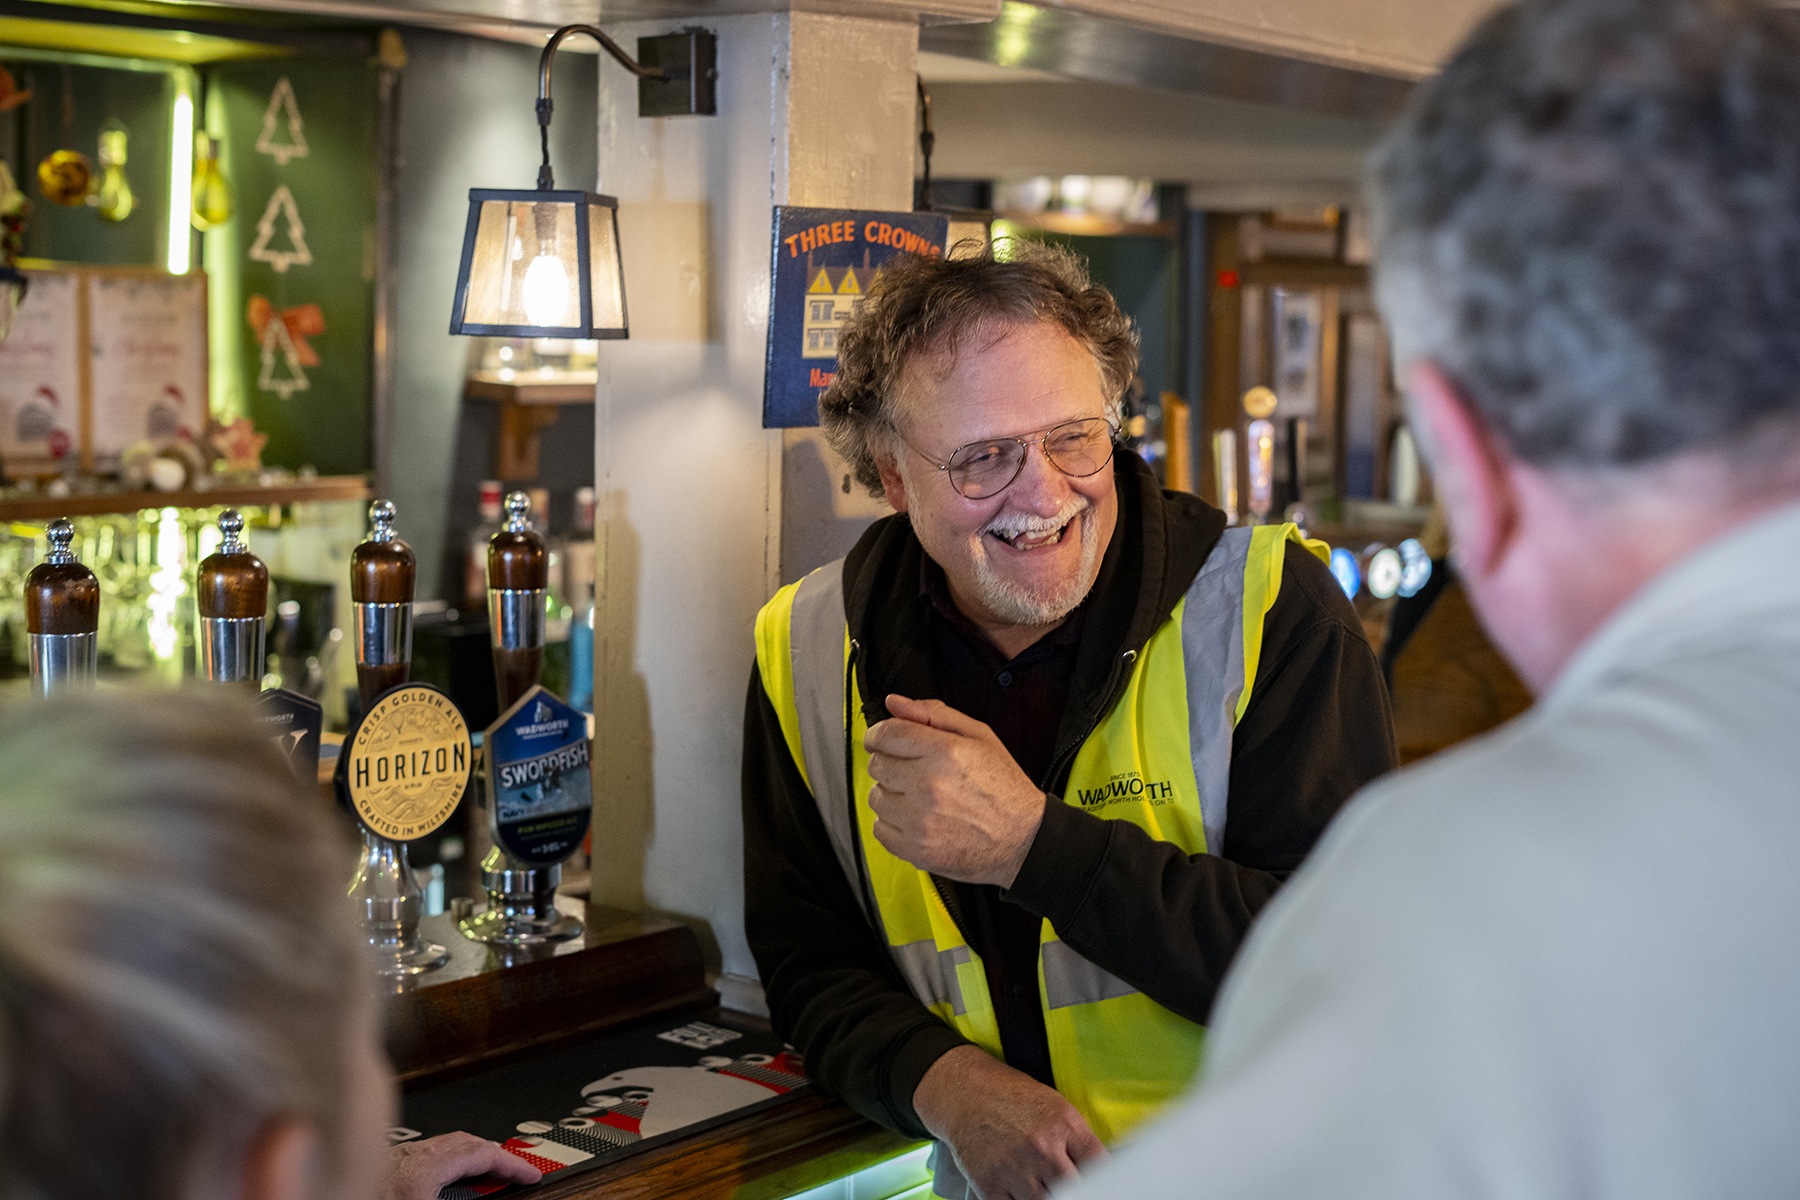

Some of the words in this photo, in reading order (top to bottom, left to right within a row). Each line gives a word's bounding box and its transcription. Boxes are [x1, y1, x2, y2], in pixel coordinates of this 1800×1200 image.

[784, 220, 856, 258] THREE
[864, 221, 941, 260] CROWNS
[256, 713, 294, 724] ADWORTH
[358, 705, 387, 746] CRISP
[392, 691, 443, 709] GOLDEN
[445, 709, 463, 732] ALE
[515, 719, 569, 735] WADWORTH
[355, 742, 466, 789] HORIZON
[1110, 773, 1126, 781] SINCE
[1078, 778, 1173, 805] WADWOTH
[359, 799, 399, 836] CRAFTED
[402, 827, 415, 836] IN
[417, 783, 463, 832] WILTSHIRE
